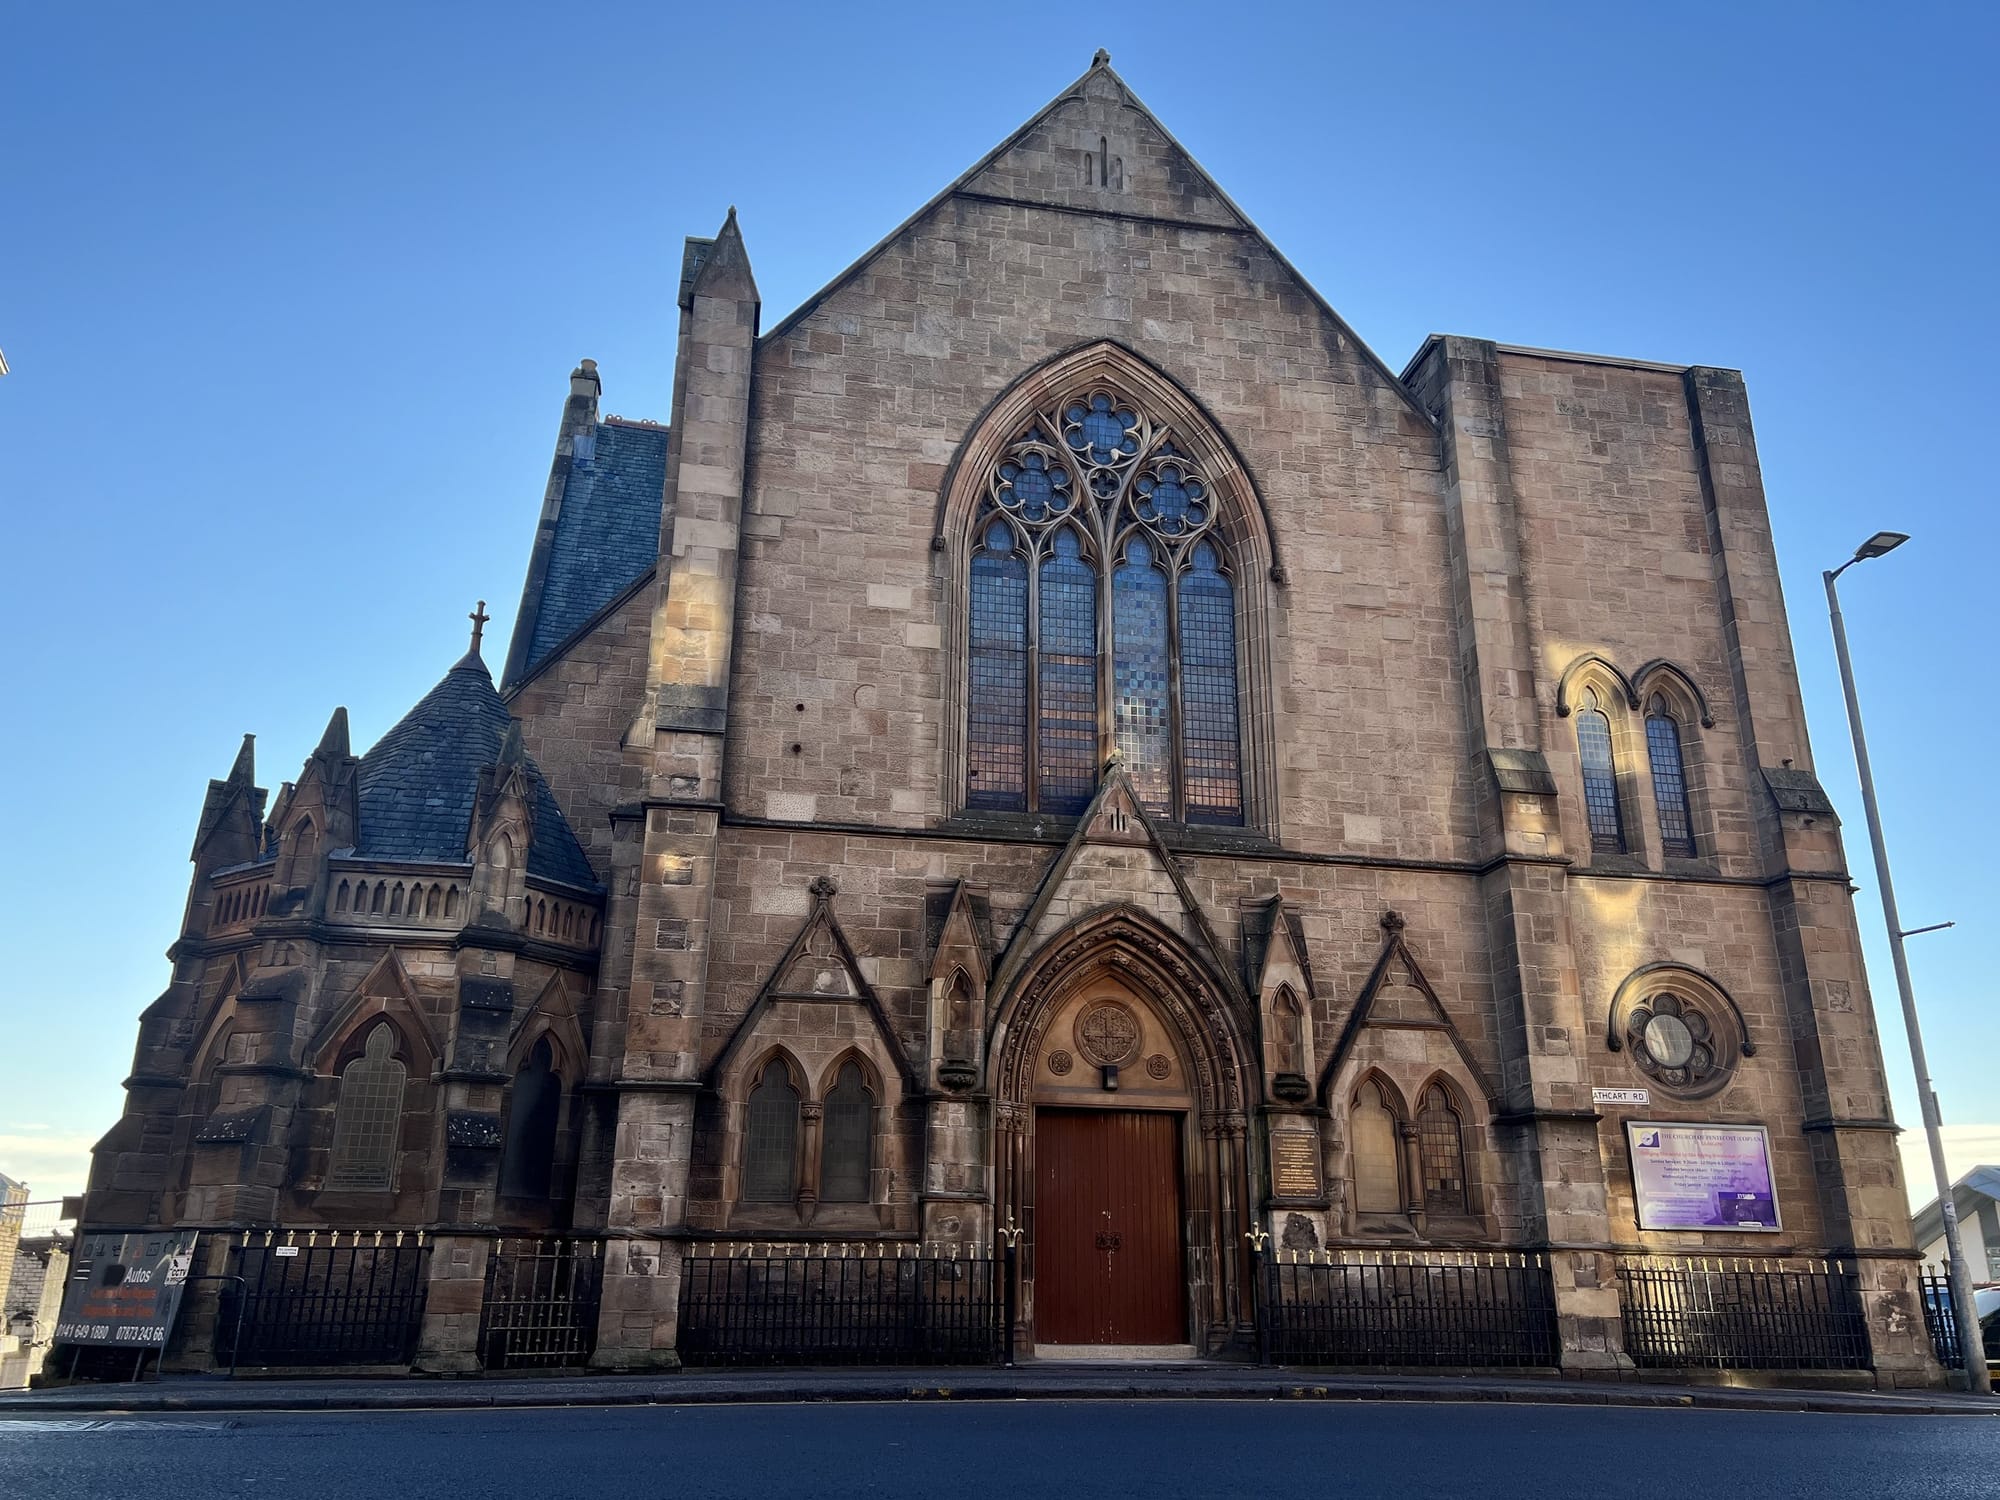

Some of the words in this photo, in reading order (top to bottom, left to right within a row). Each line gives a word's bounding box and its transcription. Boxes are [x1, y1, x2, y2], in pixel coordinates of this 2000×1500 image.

[1593, 1092, 1627, 1100] ATHCART
[1633, 1093, 1644, 1101] RD
[124, 1267, 151, 1283] Autos
[171, 1269, 187, 1277] CCTV
[56, 1324, 75, 1337] 0141
[75, 1324, 90, 1338] 649
[116, 1326, 139, 1340] 07873
[138, 1326, 154, 1340] 243
